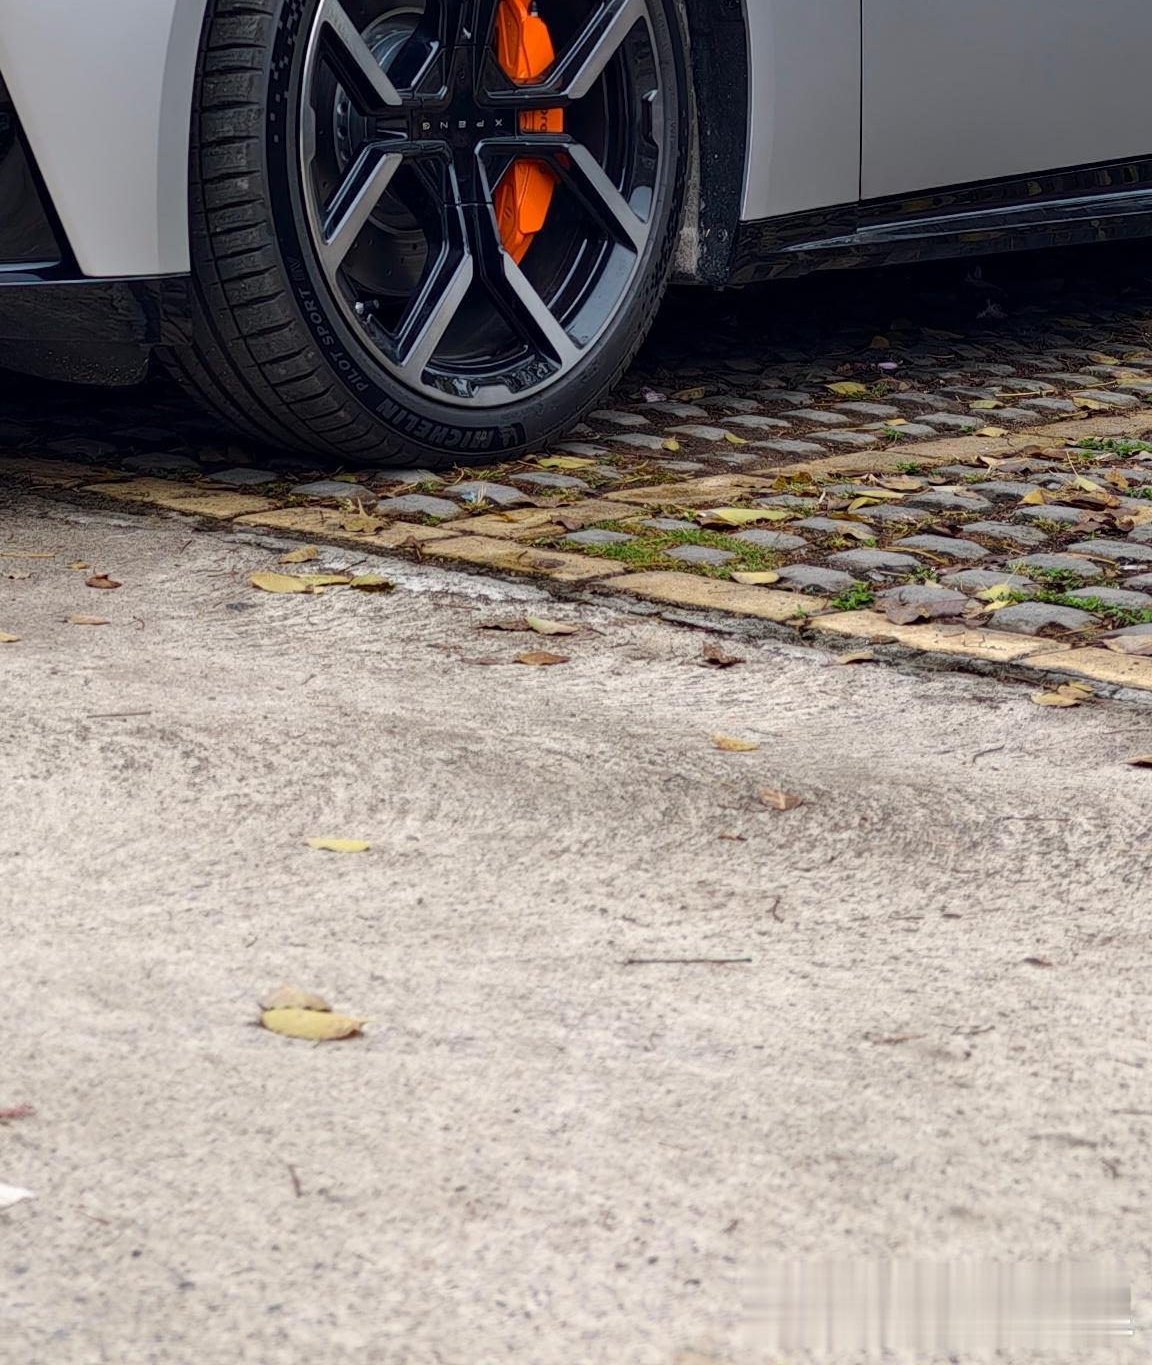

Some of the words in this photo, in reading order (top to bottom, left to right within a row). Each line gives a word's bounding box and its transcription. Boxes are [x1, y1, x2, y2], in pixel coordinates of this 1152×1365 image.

[421, 117, 504, 131] XPENG
[298, 287, 335, 347] SPORT
[329, 350, 369, 392] PILOT
[376, 398, 494, 449] MICHELIN
